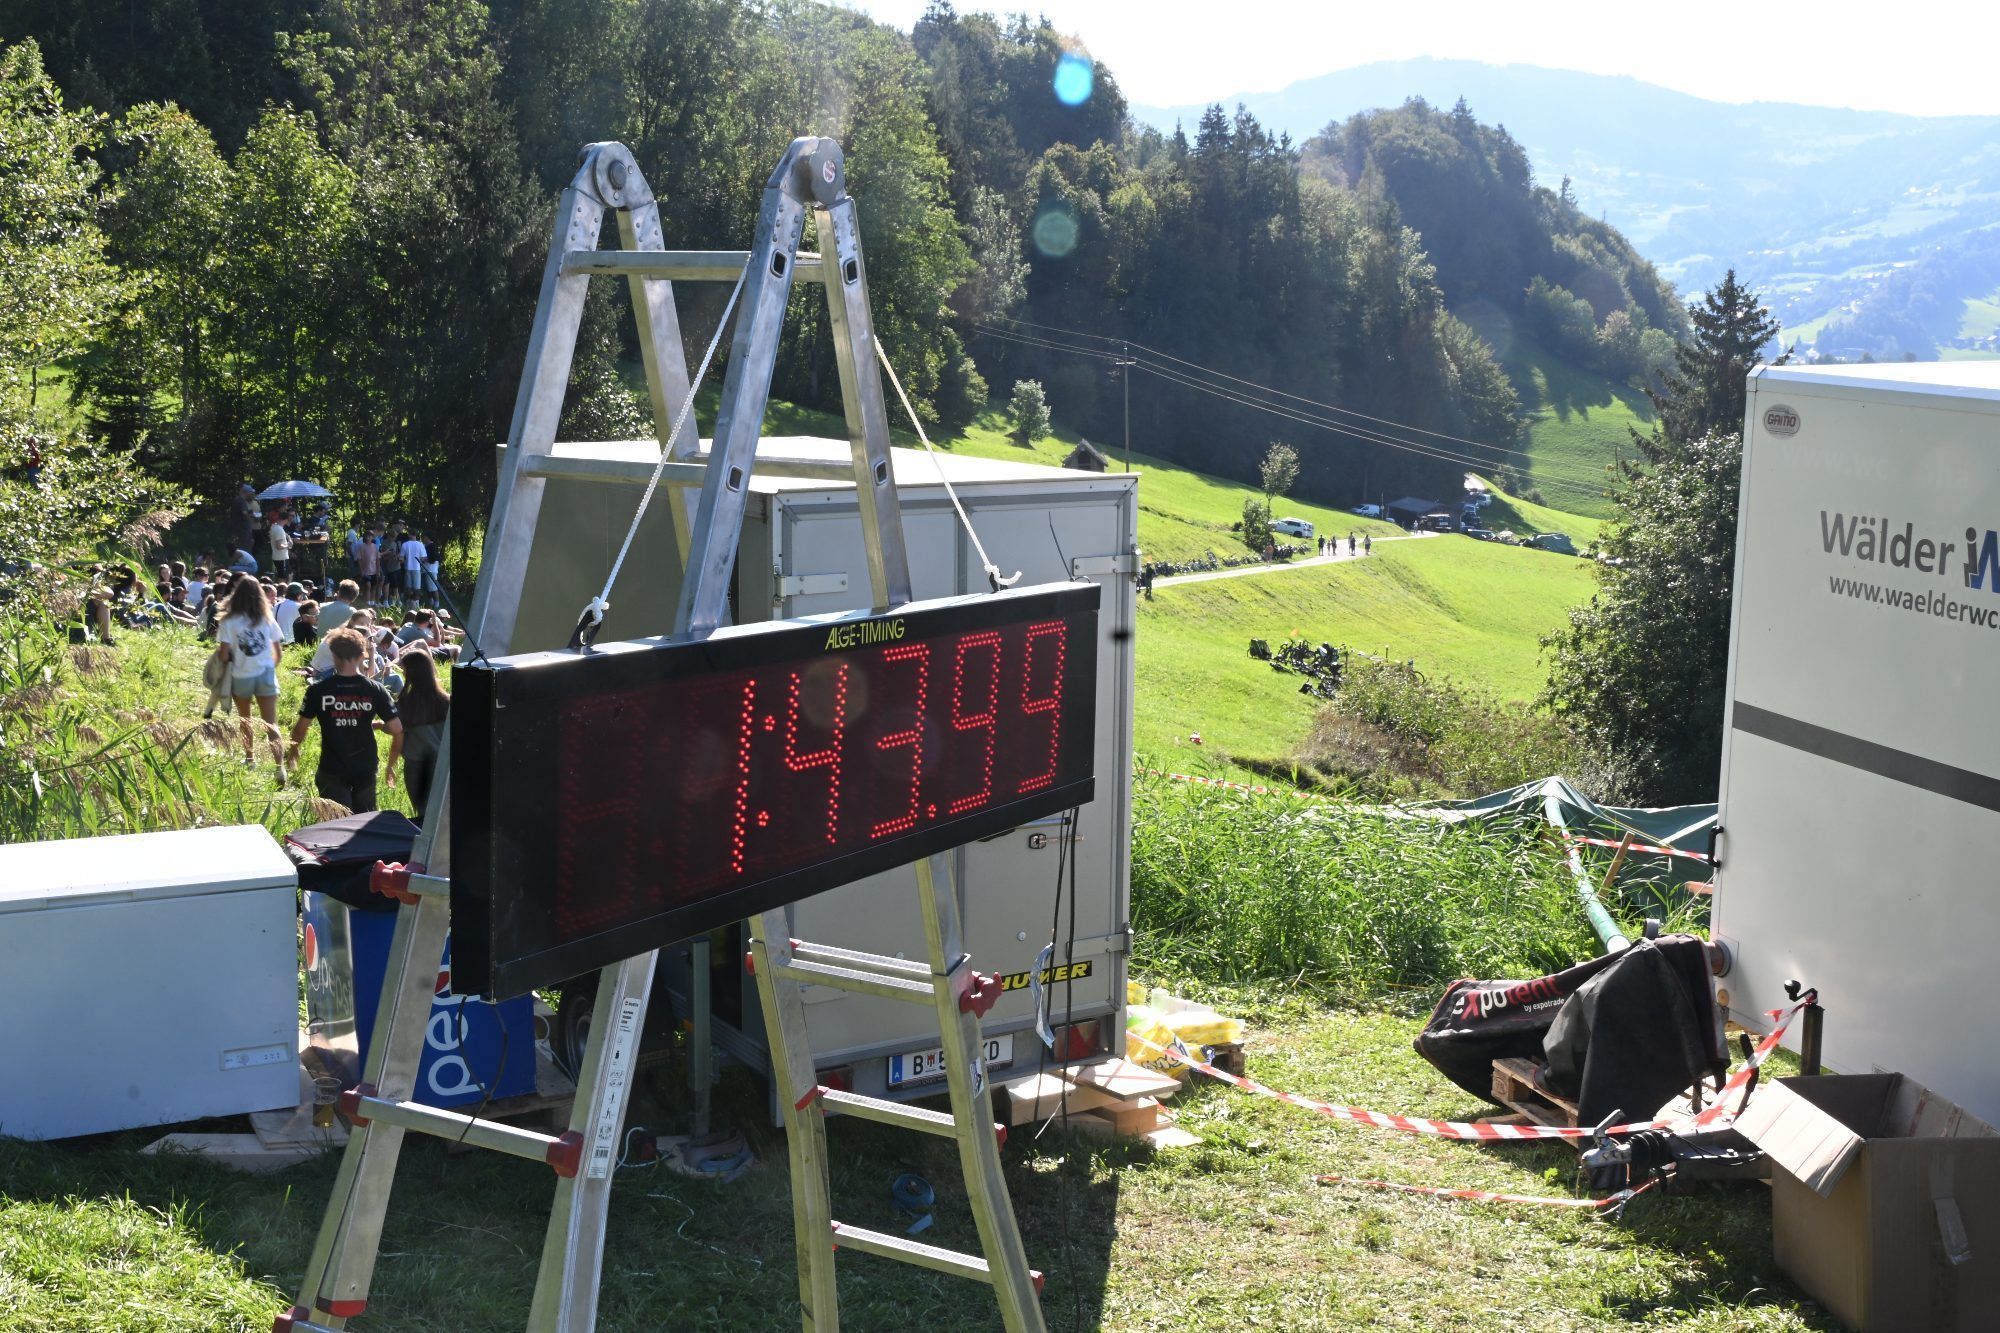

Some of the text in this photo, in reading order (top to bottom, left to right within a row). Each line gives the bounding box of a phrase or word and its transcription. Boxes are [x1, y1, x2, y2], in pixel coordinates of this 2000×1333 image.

[1820, 510, 1955, 575] Wälder
[824, 618, 905, 651] ALGE-TIMING
[321, 694, 373, 711] POLAND
[335, 718, 358, 727] 2019
[732, 619, 1068, 874] 1:43.99
[1452, 976, 1563, 1021] expotent
[1523, 1004, 1532, 1013] by
[913, 1055, 924, 1076] B
